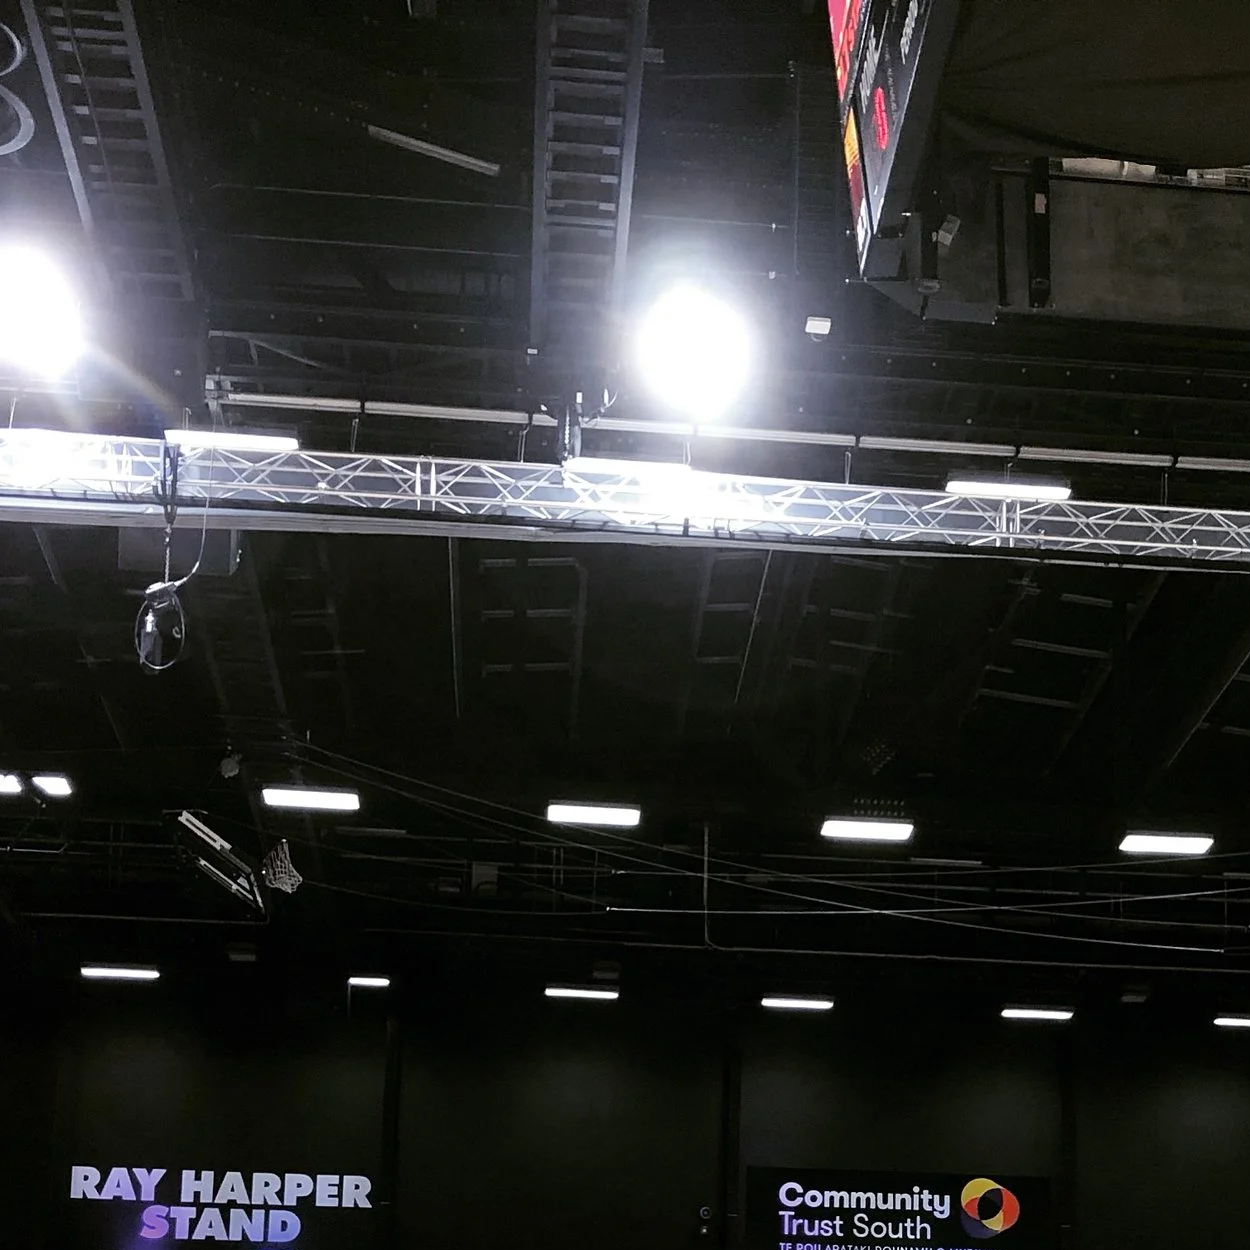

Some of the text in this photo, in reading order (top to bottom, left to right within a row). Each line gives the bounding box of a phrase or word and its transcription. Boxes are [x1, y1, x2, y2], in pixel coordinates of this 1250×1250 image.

[70, 1166, 372, 1208] RAY HARPER
[778, 1181, 951, 1219] Community
[139, 1204, 302, 1242] STAND
[778, 1210, 932, 1240] Trust South
